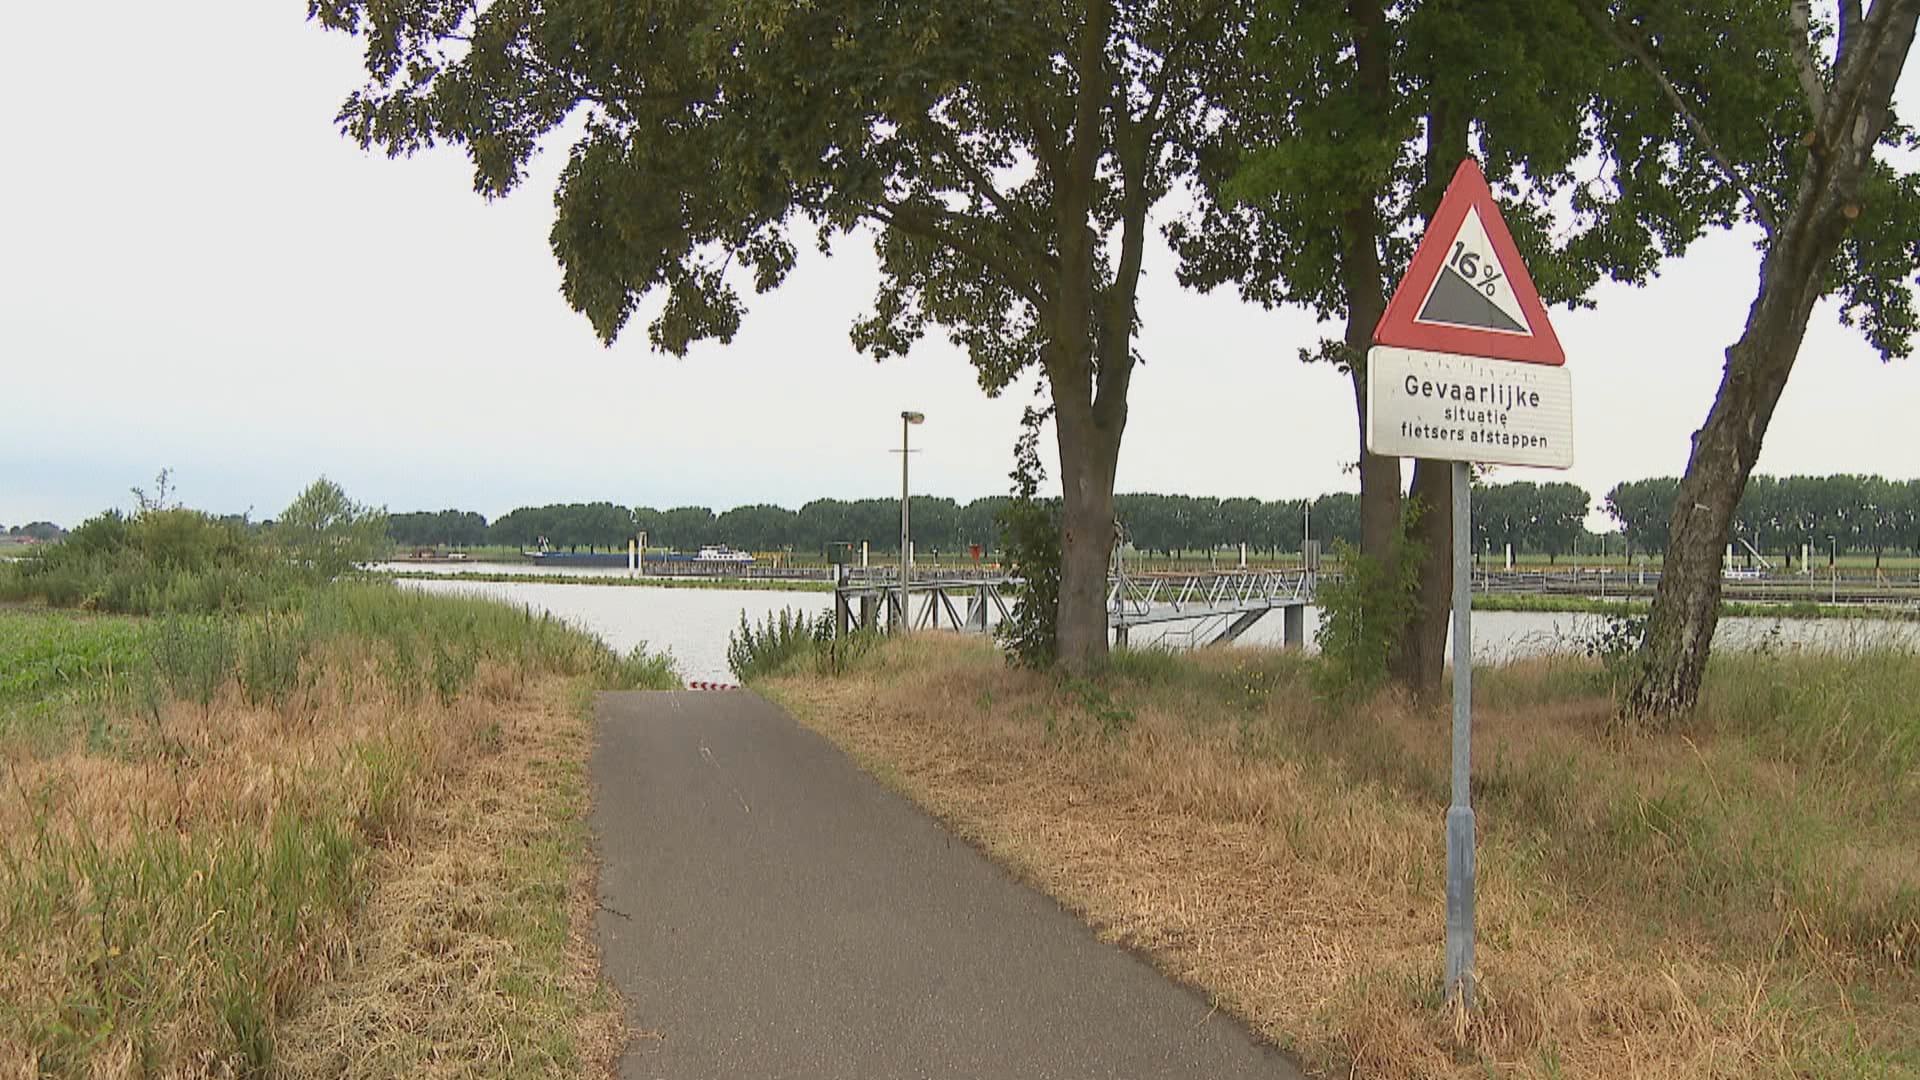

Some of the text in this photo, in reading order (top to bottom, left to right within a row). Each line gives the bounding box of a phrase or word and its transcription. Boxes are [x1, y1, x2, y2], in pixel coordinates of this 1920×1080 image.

[1450, 241, 1503, 297] 16%
[1405, 375, 1540, 410] Gevaarlijke
[1445, 407, 1508, 426] situatie
[1401, 423, 1548, 449] fietsers afstappen
